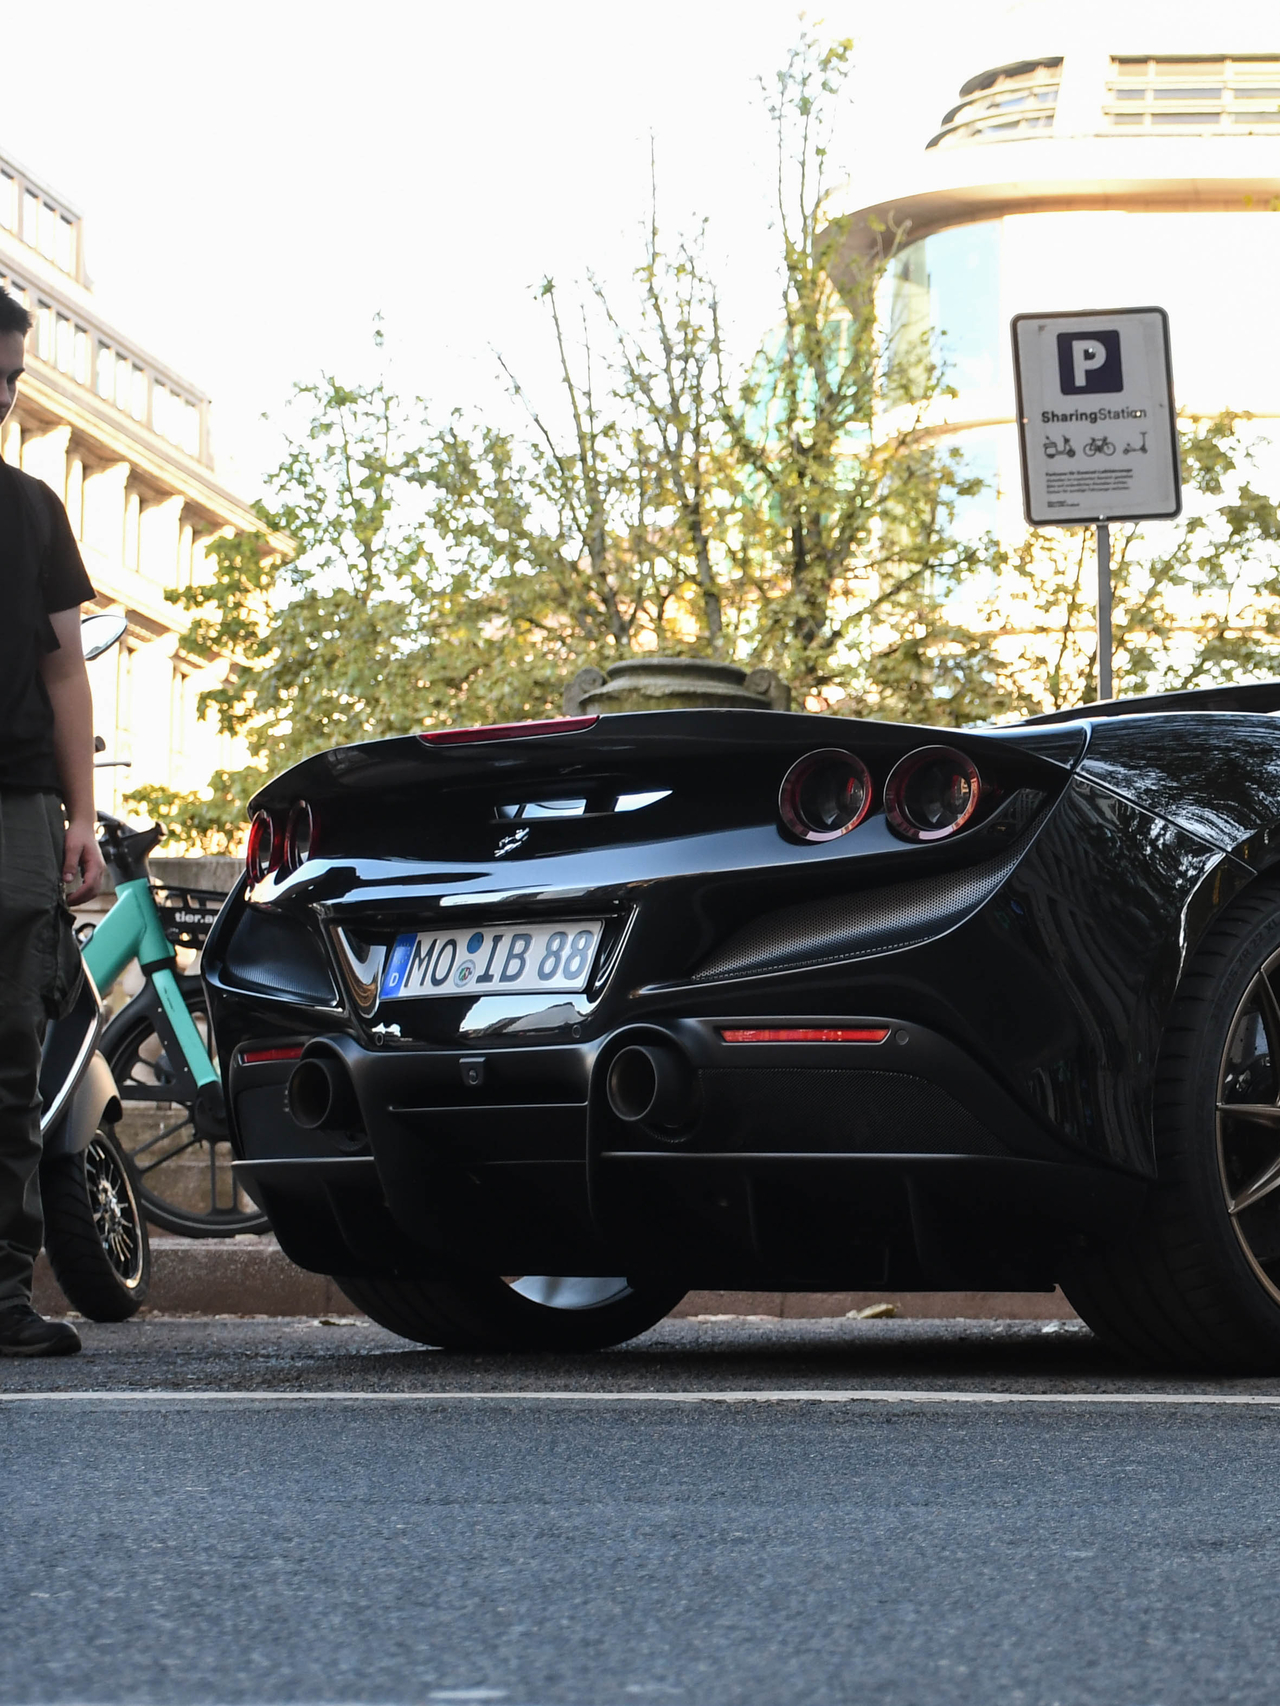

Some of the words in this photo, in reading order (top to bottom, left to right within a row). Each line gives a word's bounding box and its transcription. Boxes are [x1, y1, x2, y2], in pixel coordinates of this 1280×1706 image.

[1071, 339, 1107, 388] P
[1041, 405, 1147, 424] SharingStation
[404, 938, 457, 988] MO
[475, 933, 533, 984] IB
[537, 930, 594, 982] 88
[389, 973, 399, 987] D
